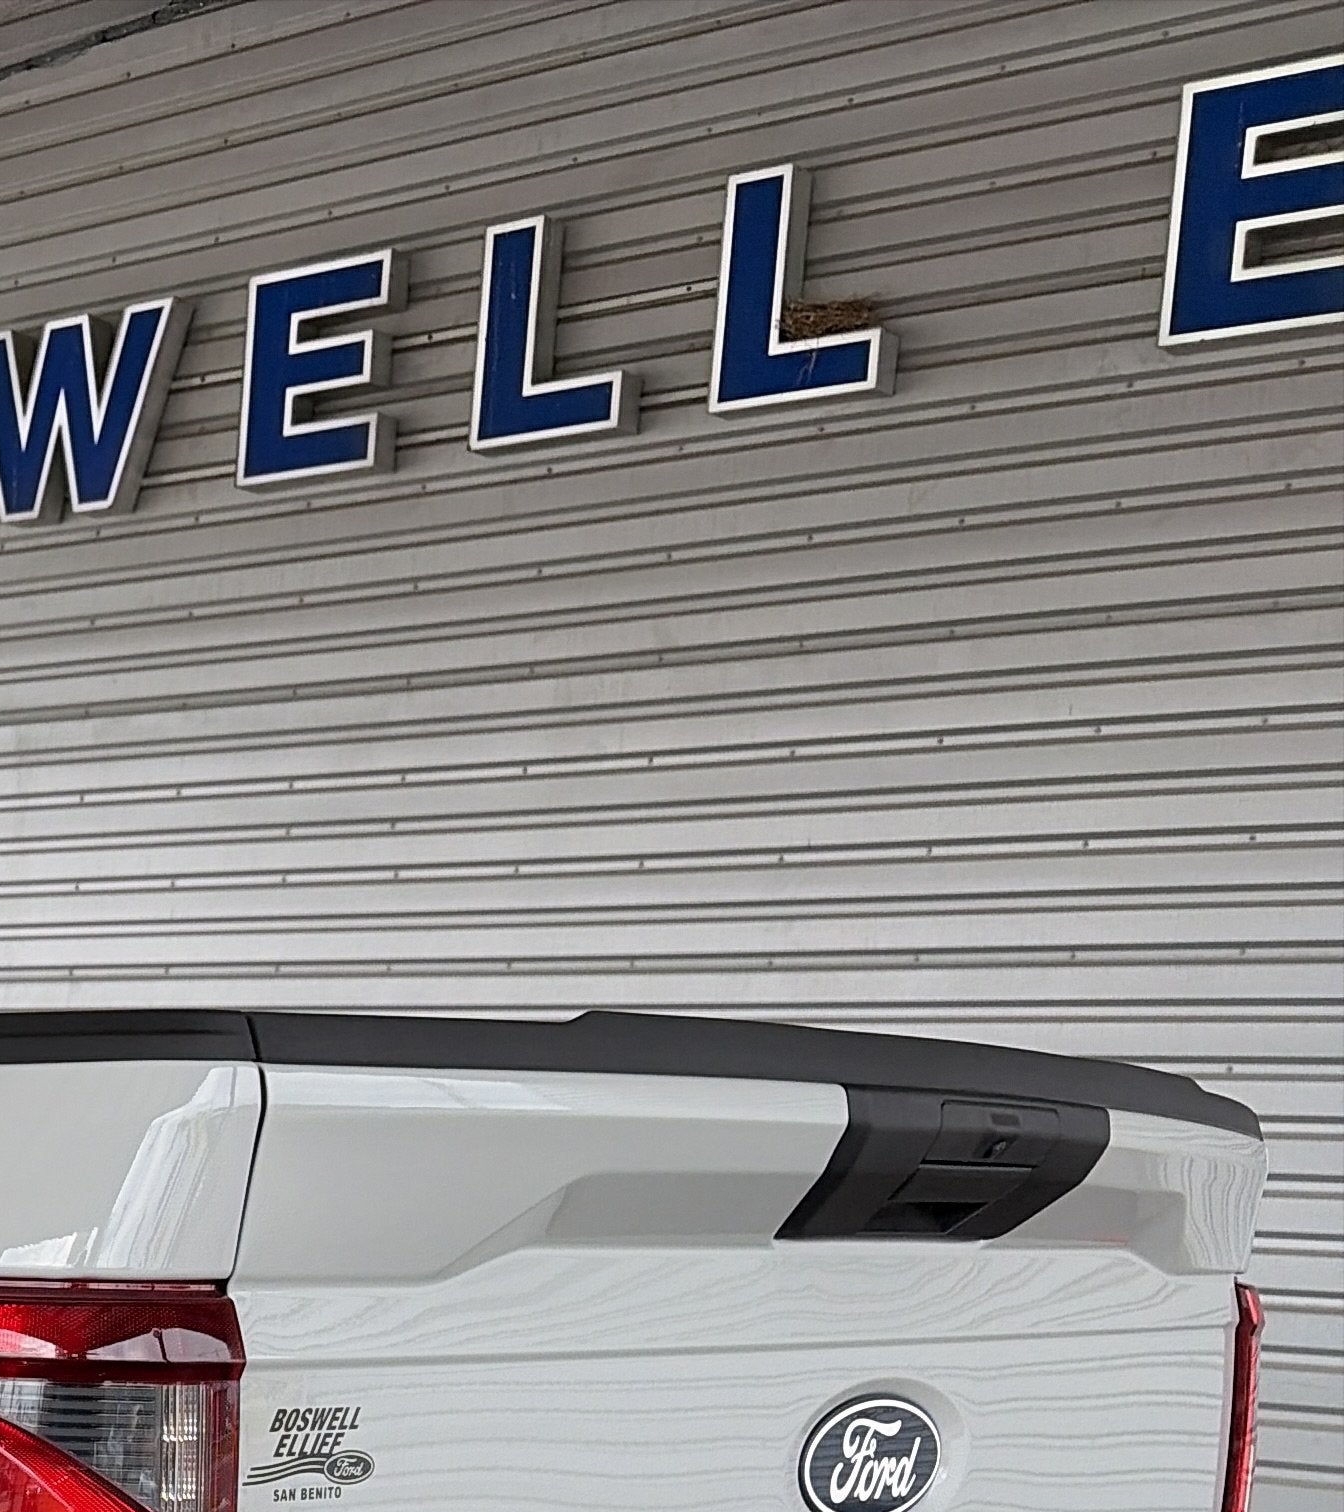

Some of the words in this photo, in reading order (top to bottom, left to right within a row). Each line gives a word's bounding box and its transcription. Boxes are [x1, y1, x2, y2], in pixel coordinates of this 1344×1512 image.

[269, 1406, 362, 1432] BOSWELL
[273, 1431, 345, 1458] ELLIFF
[333, 1457, 365, 1479] Ford
[829, 1416, 920, 1504] Ford
[272, 1487, 296, 1502] SAN
[300, 1486, 342, 1501] BENITO
